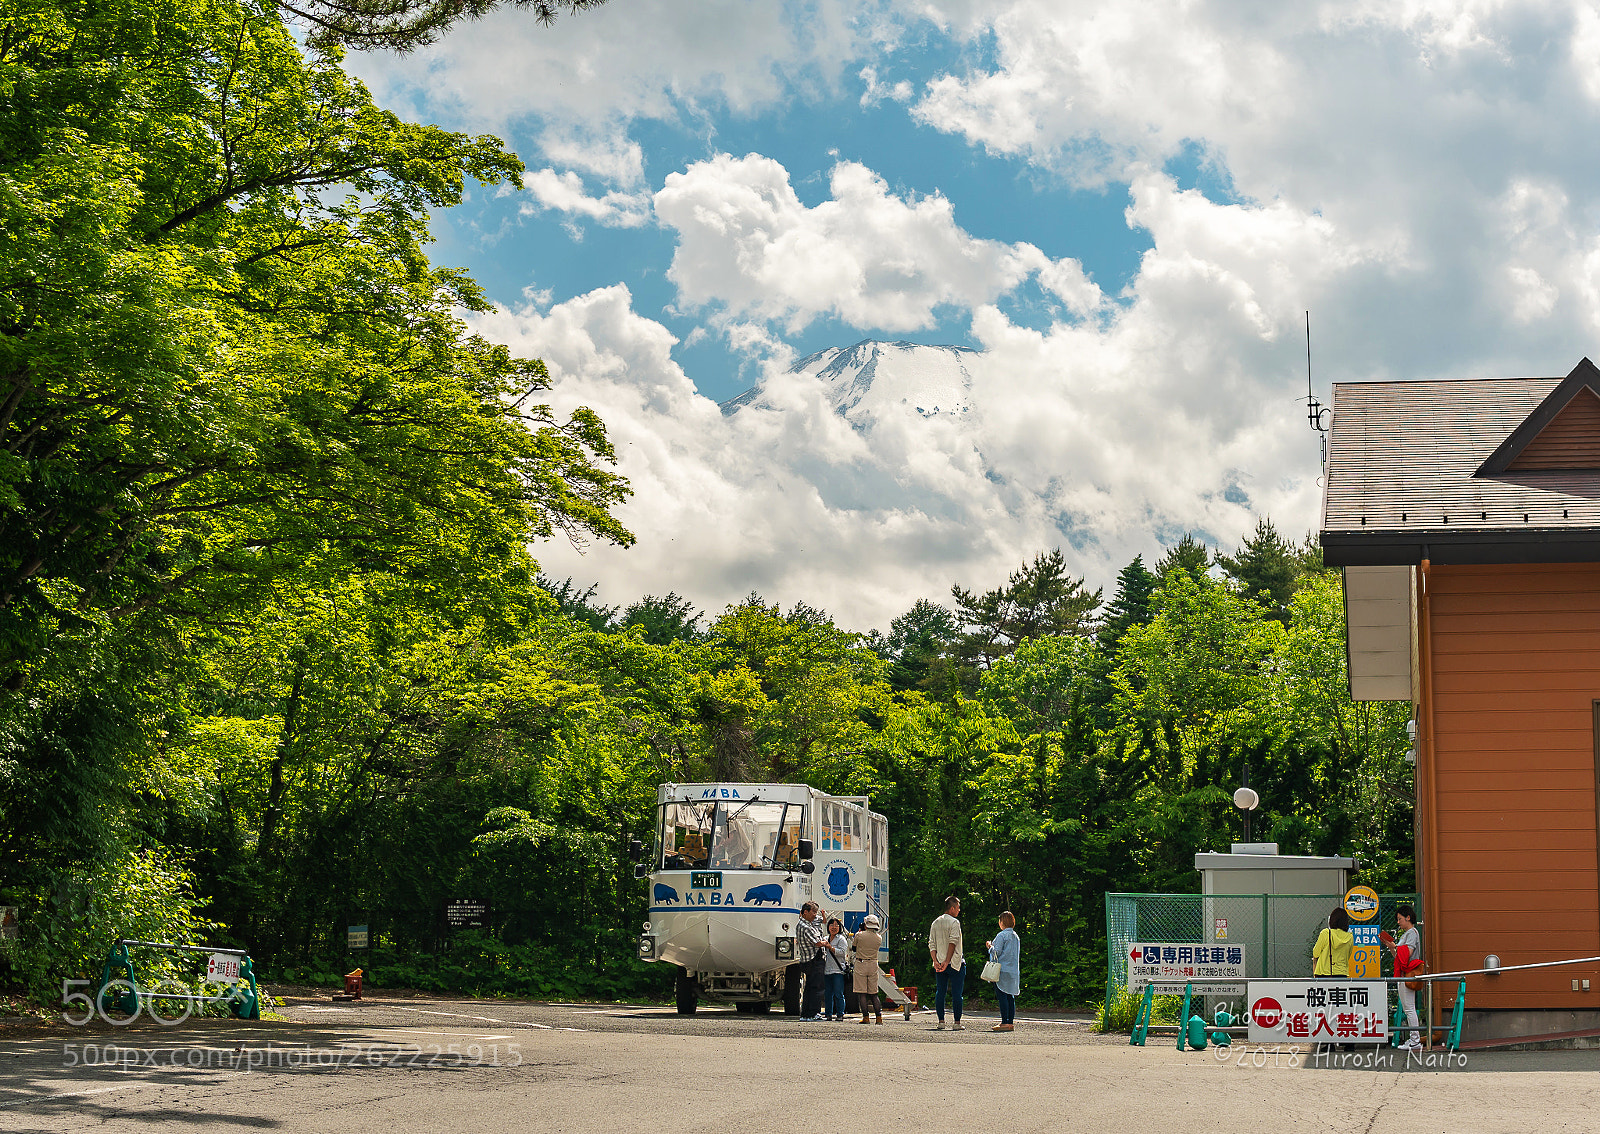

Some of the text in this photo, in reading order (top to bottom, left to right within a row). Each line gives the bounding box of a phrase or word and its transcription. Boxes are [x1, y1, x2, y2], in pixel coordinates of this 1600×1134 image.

[702, 788, 740, 799] KABA
[685, 892, 735, 906] KABA
[1354, 935, 1378, 944] ABA
[1161, 946, 1242, 965] 専用駐車場
[1368, 948, 1377, 964] カバ
[1285, 987, 1369, 1008] 一般車両
[1286, 1012, 1385, 1038] 進入禁止
